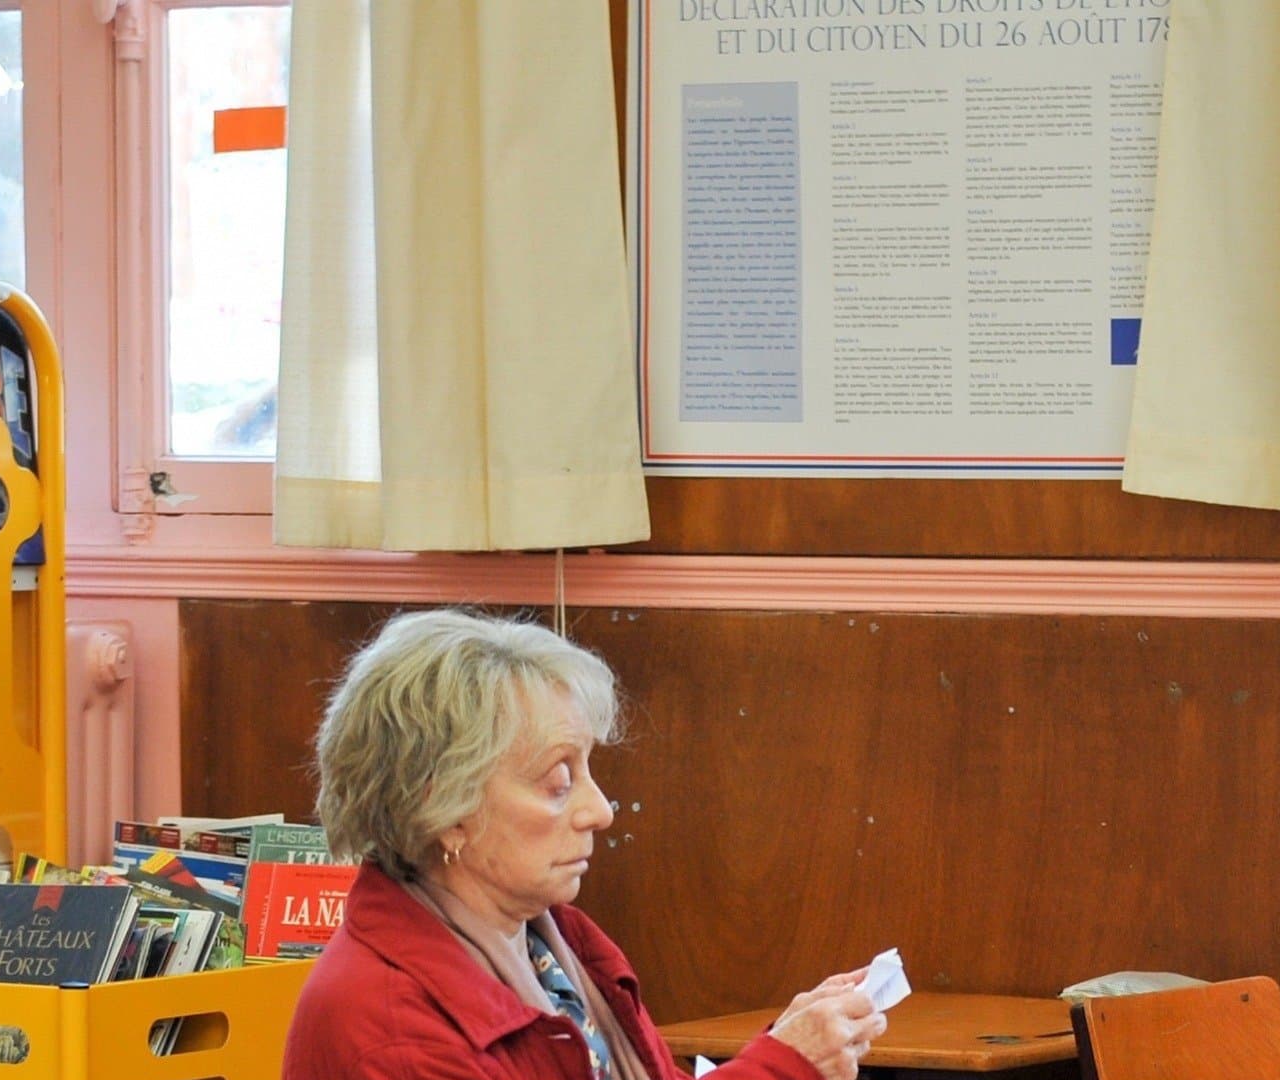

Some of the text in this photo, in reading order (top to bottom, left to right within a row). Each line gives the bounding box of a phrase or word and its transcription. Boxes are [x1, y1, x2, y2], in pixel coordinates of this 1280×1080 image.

[716, 29, 747, 55] ET
[756, 28, 797, 53] DU
[806, 24, 928, 53] CITOYEN
[939, 22, 983, 48] DU
[995, 20, 1027, 47] 26
[1038, 12, 1128, 46] AOÛT
[267, 829, 326, 844] L'HISTOIR
[31, 913, 51, 926] Les
[281, 895, 311, 926] LA
[314, 897, 345, 927] NA
